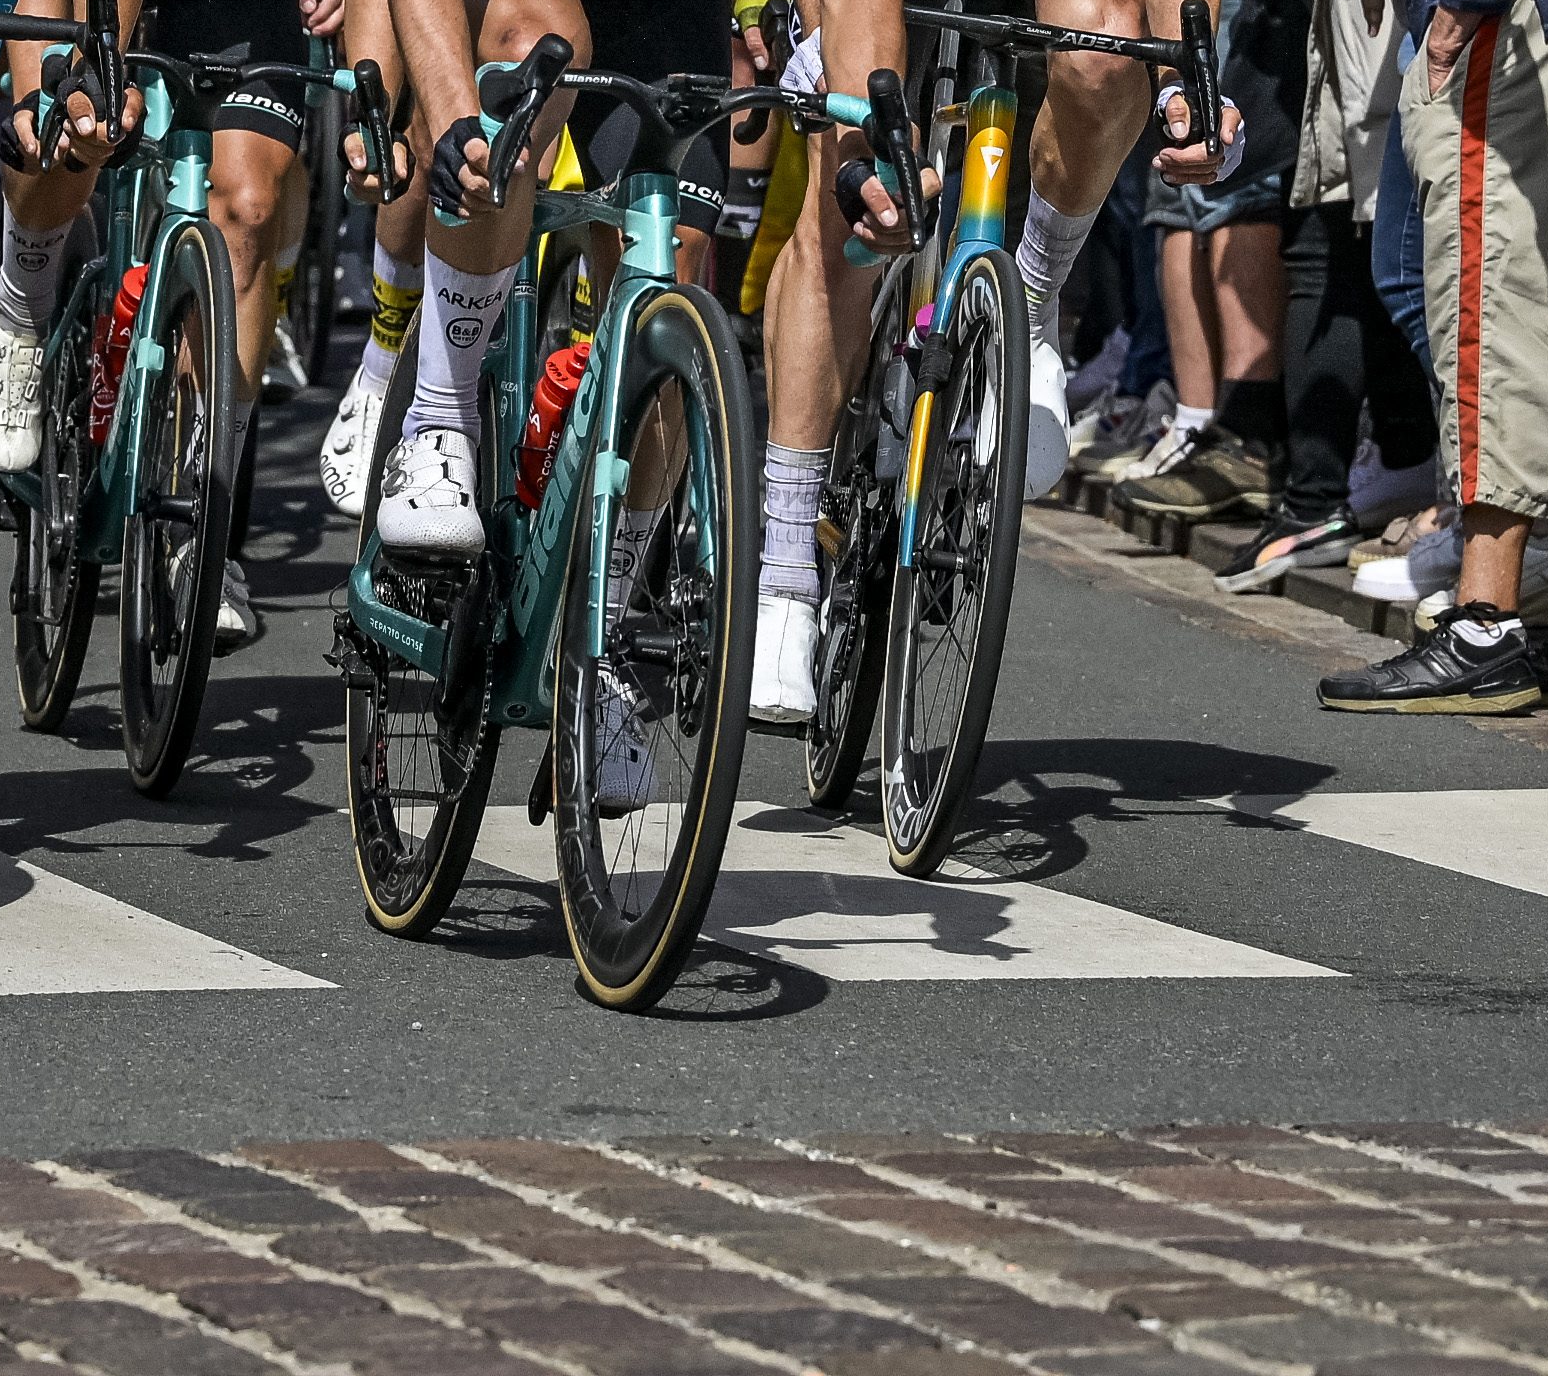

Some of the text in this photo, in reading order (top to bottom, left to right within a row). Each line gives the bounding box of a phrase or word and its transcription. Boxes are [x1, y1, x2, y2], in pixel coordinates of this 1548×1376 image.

[1060, 30, 1126, 52] ADEX
[564, 74, 612, 85] Bianchi
[225, 90, 303, 126] ianchi
[438, 287, 503, 310] ARKEA
[369, 617, 424, 654] REPARTO CORSE
